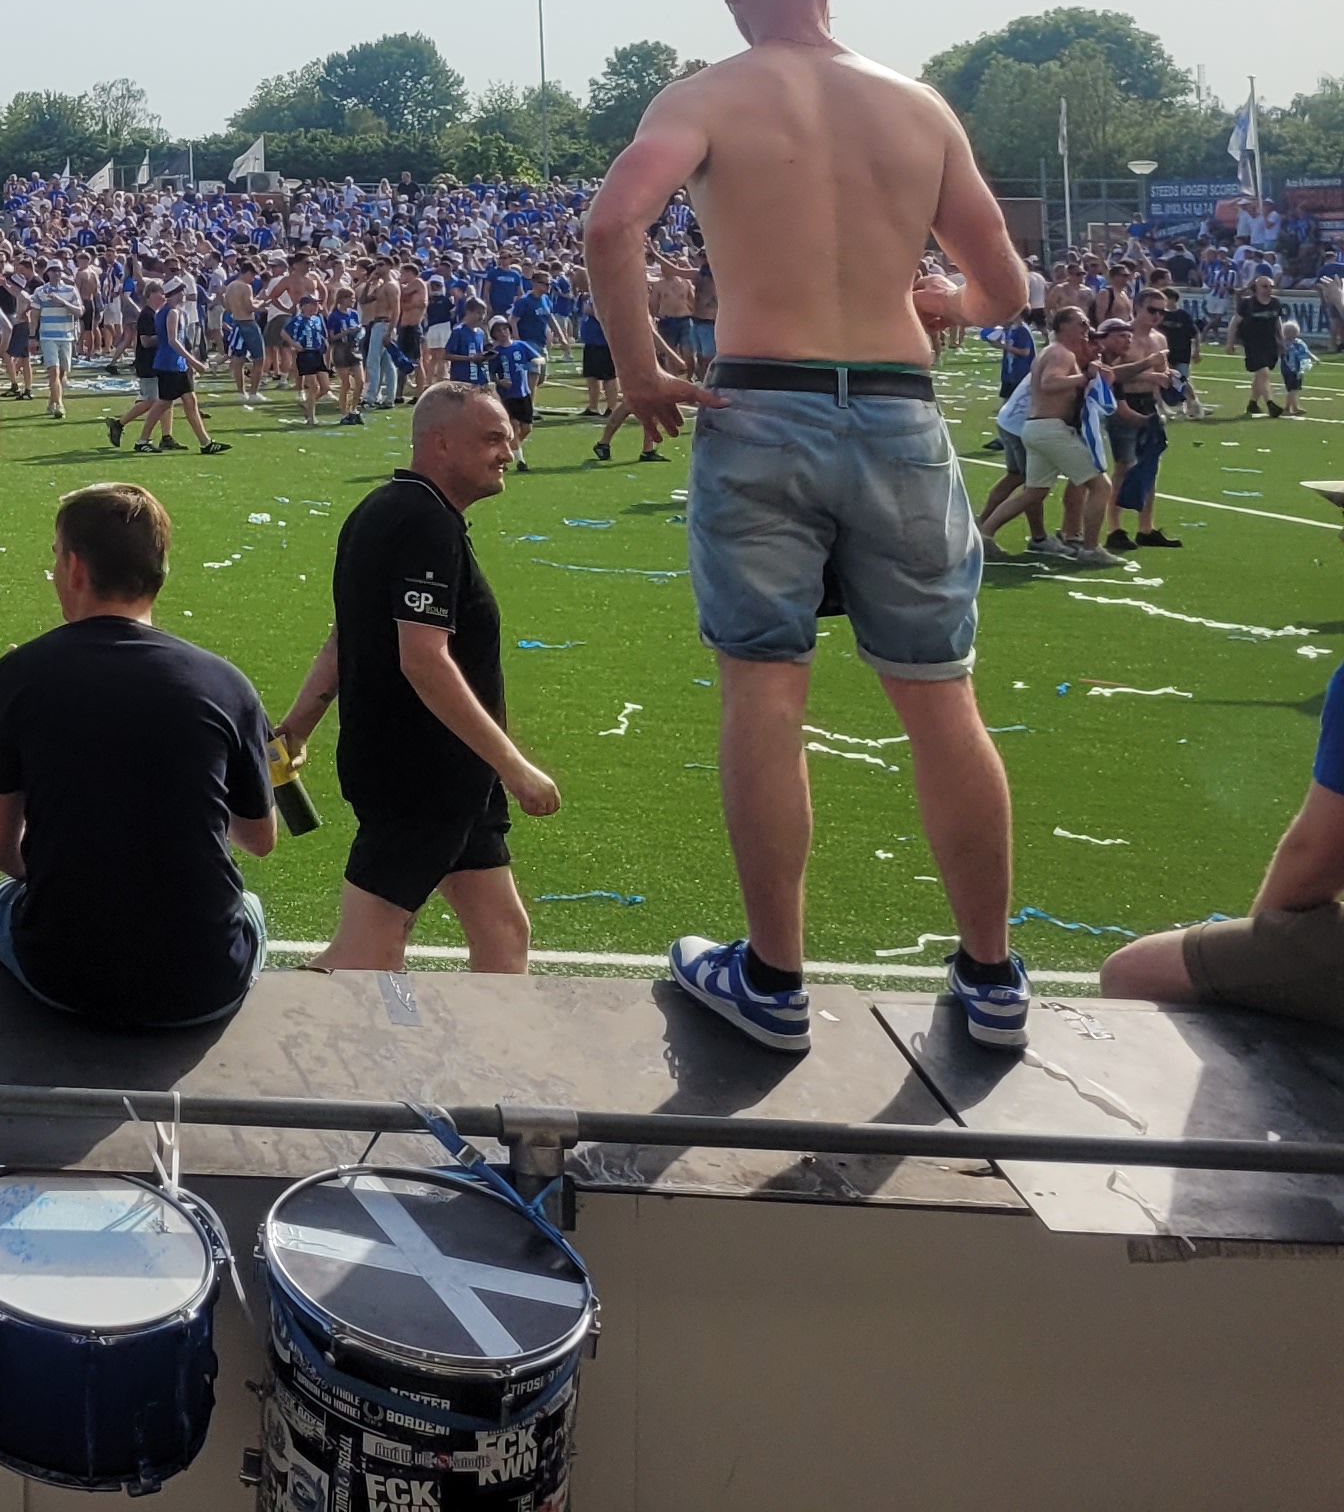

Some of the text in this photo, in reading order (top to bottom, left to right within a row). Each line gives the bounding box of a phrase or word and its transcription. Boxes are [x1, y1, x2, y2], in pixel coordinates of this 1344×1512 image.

[386, 1409, 450, 1436] BORDEN!
[475, 1422, 538, 1460] FCK
[477, 1446, 538, 1487] KWN
[365, 1472, 439, 1507] FCK
